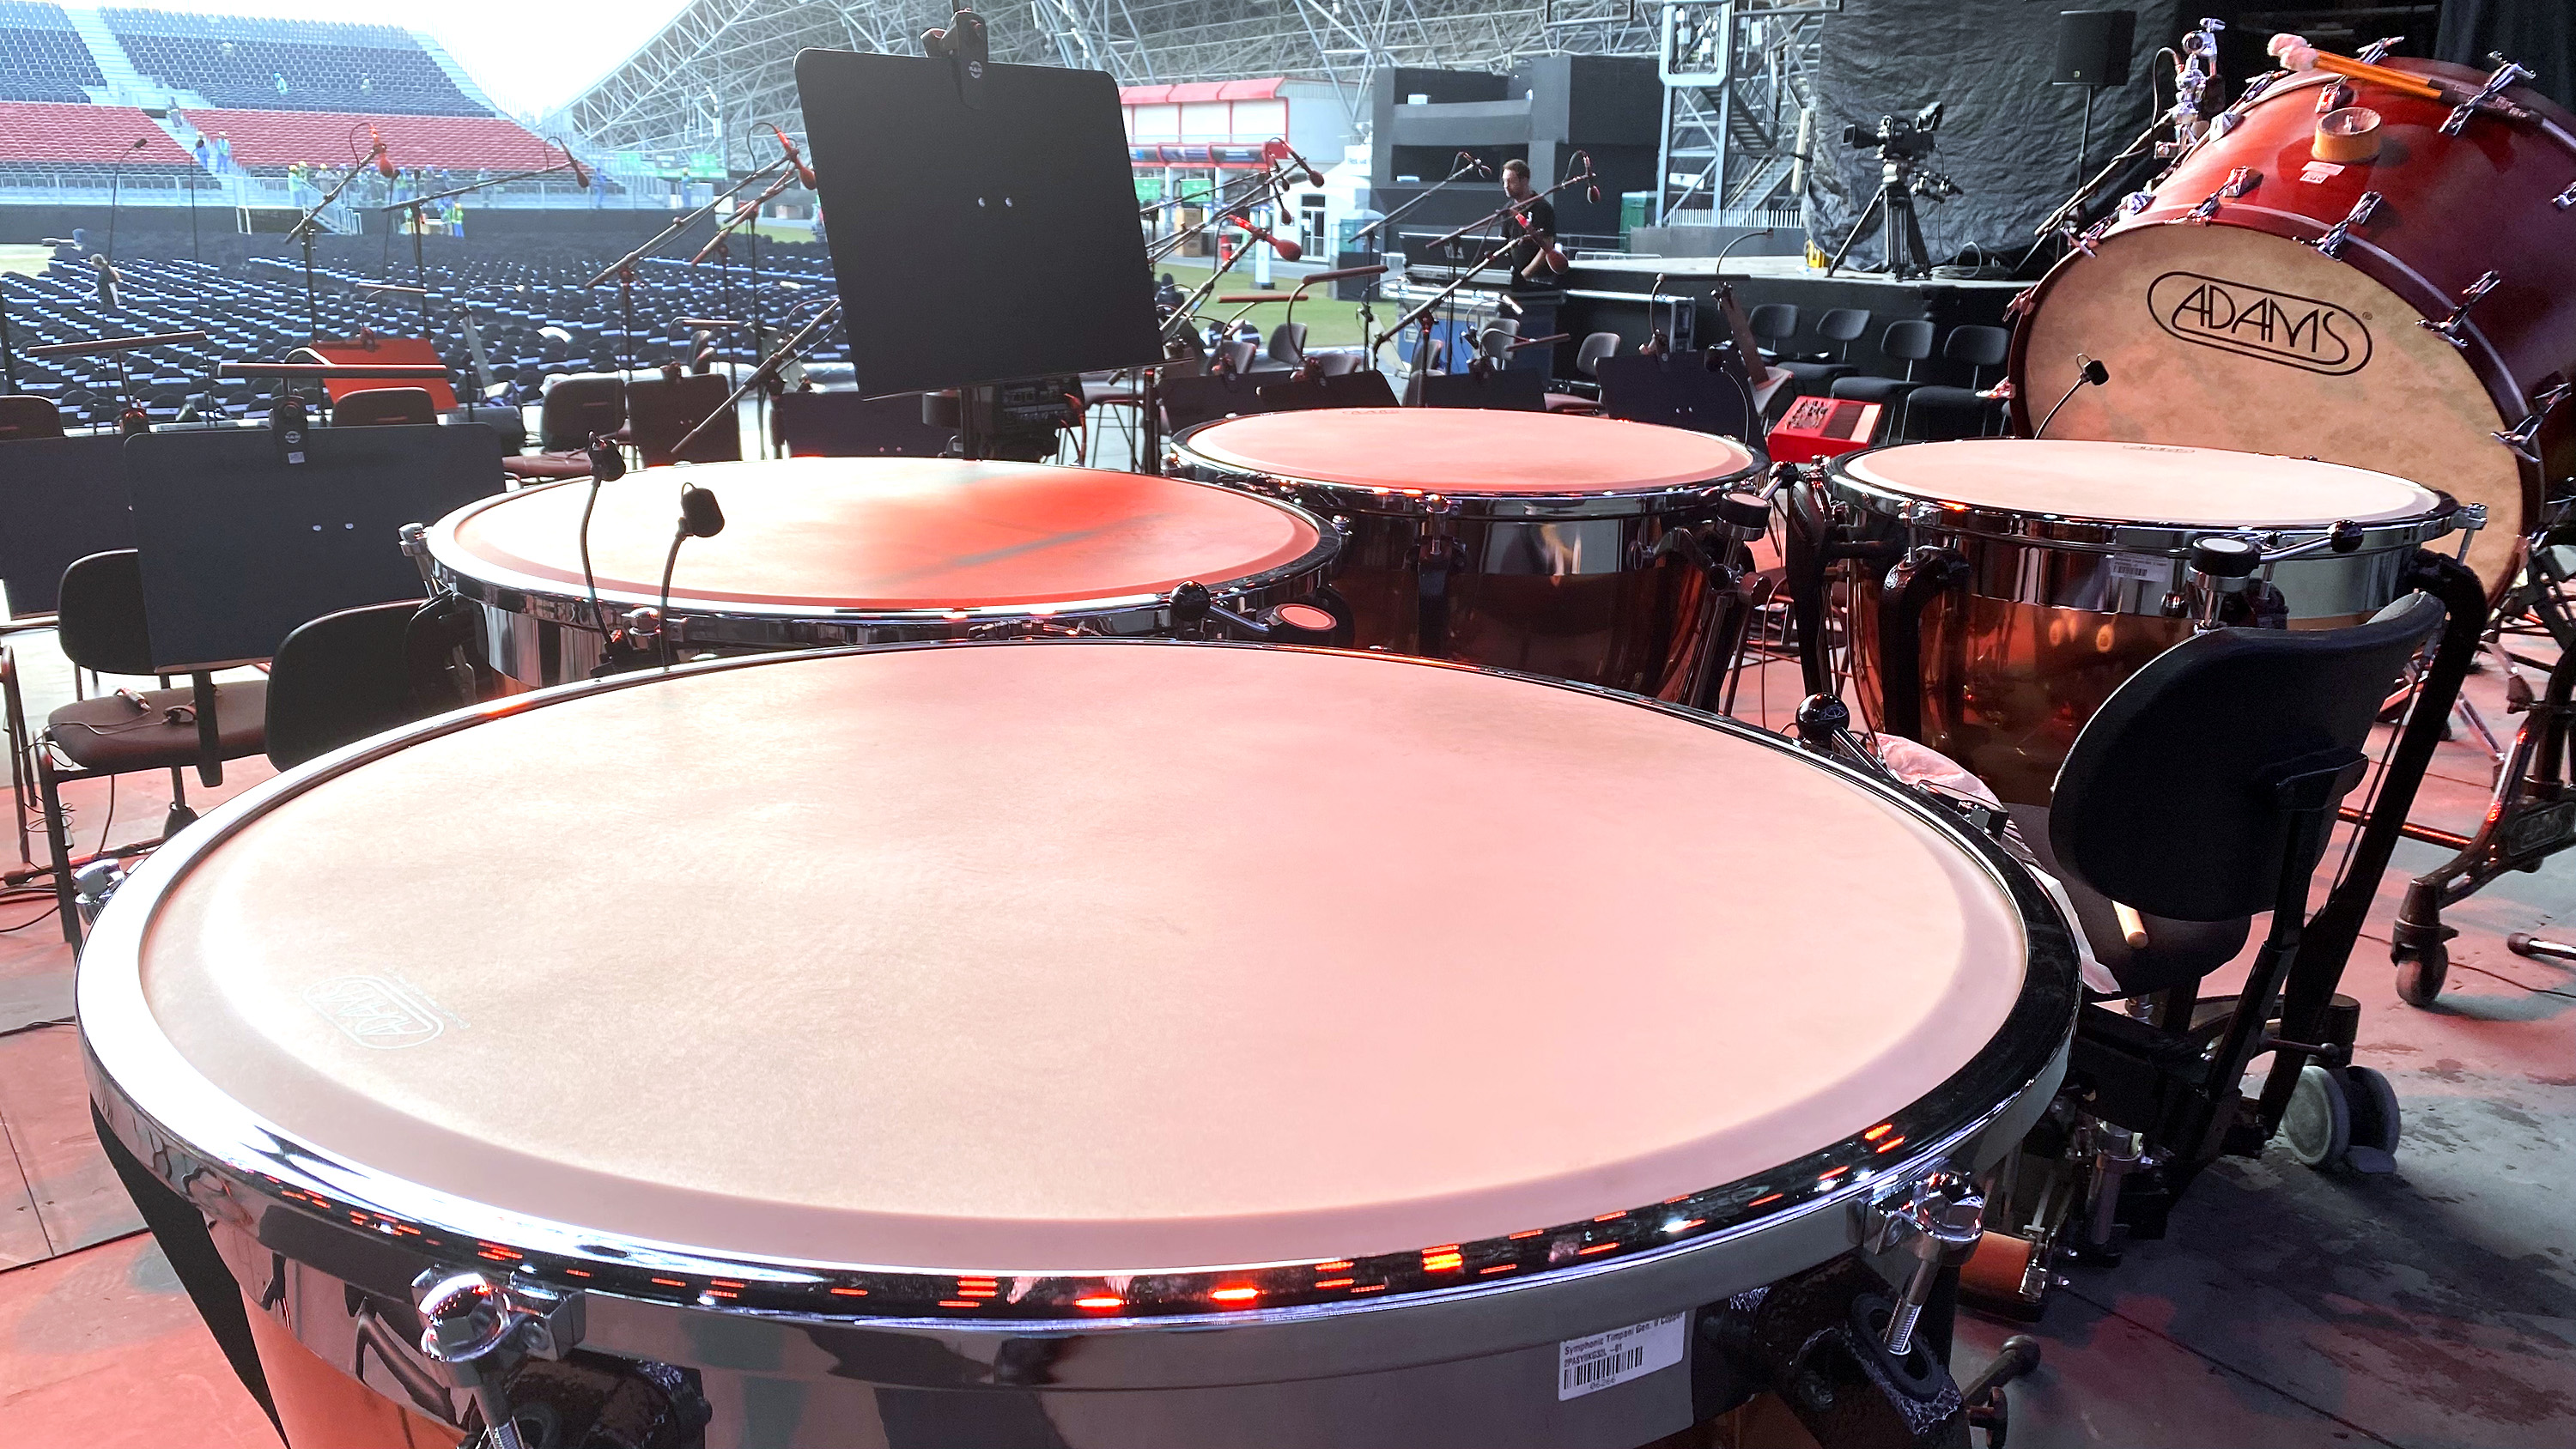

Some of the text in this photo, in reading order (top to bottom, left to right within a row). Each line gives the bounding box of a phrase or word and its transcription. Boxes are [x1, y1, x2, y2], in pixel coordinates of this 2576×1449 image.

[2172, 283, 2350, 366] ADAMS
[1564, 1337, 1604, 1355] Symphonic
[1607, 1330, 1633, 1342] Timpani
